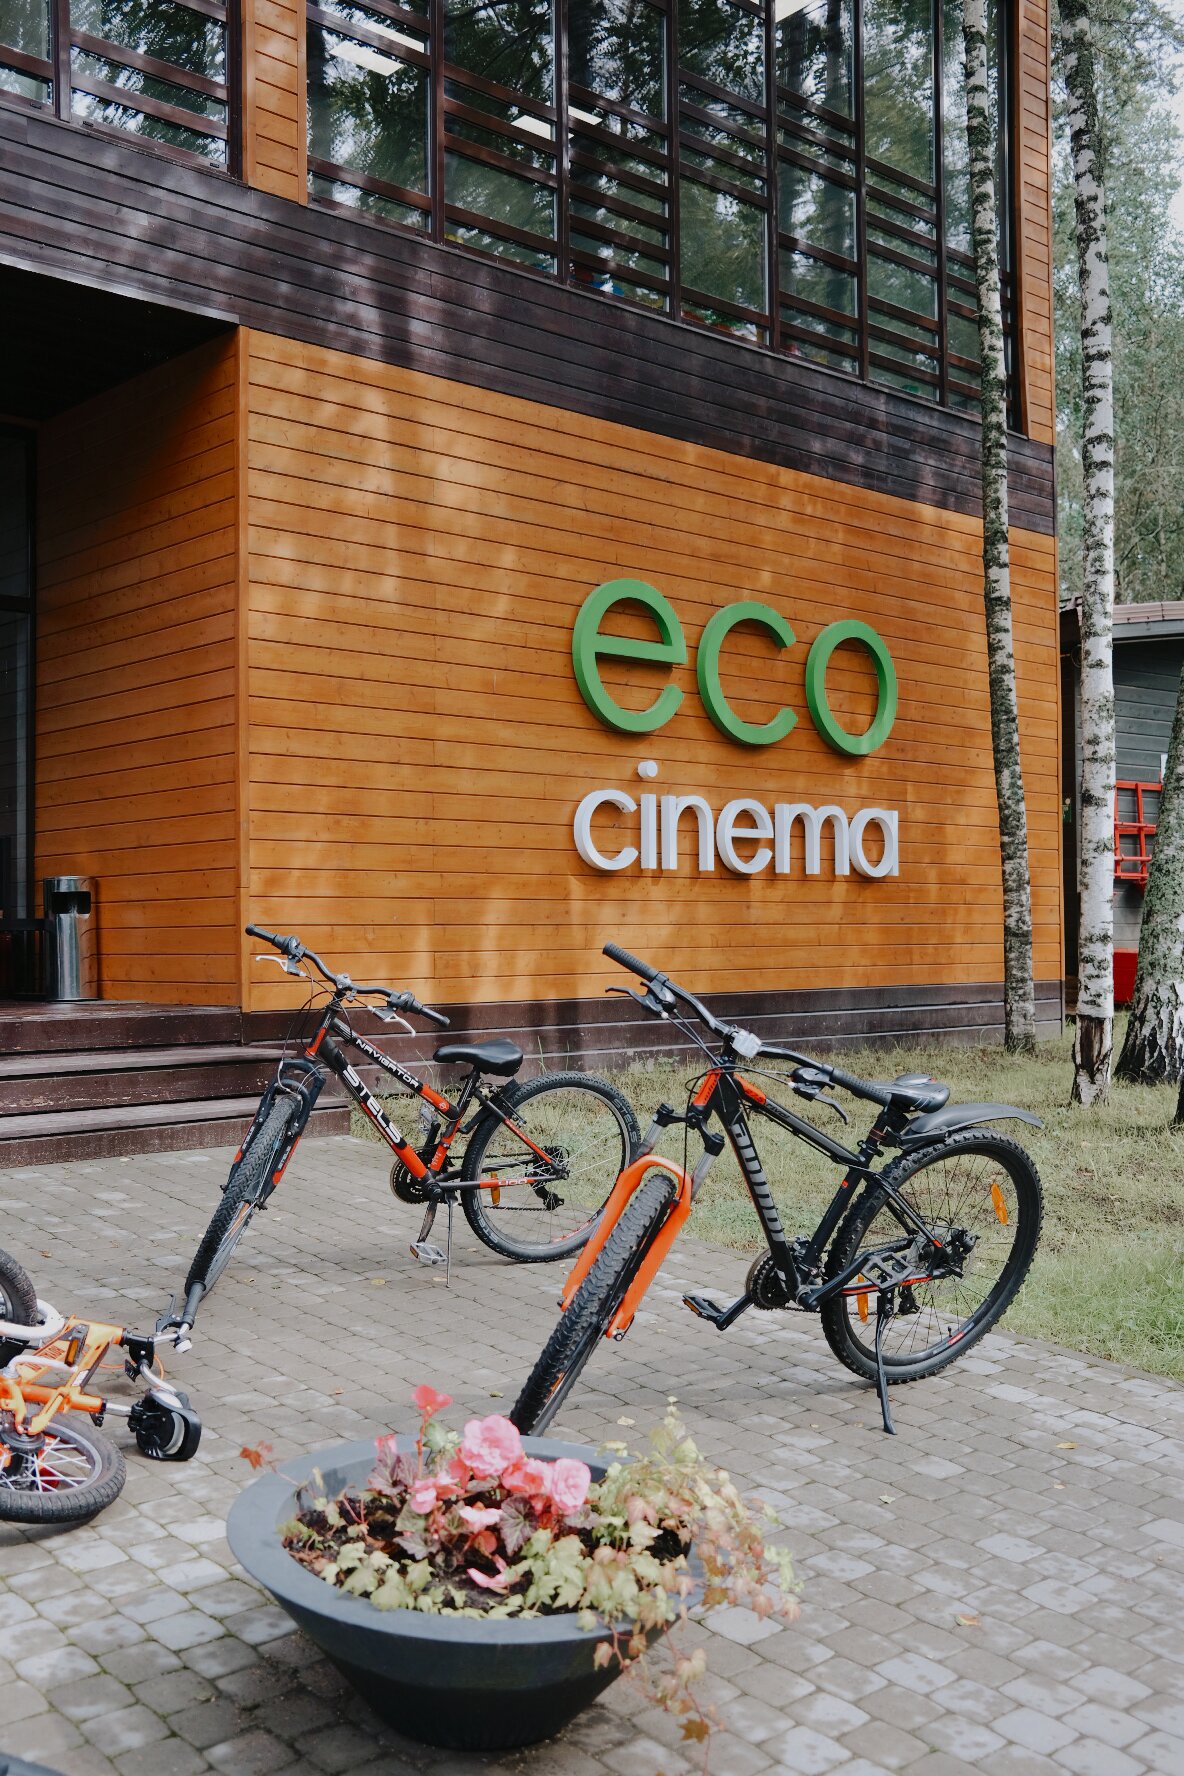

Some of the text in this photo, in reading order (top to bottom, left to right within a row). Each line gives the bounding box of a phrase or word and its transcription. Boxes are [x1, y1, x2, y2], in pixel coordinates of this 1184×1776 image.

[572, 578, 898, 756] eco
[573, 760, 899, 878] cinema
[355, 1038, 419, 1089] NAVIGATOR
[343, 1064, 401, 1144] STELS
[611, 1098, 638, 1143] STELS
